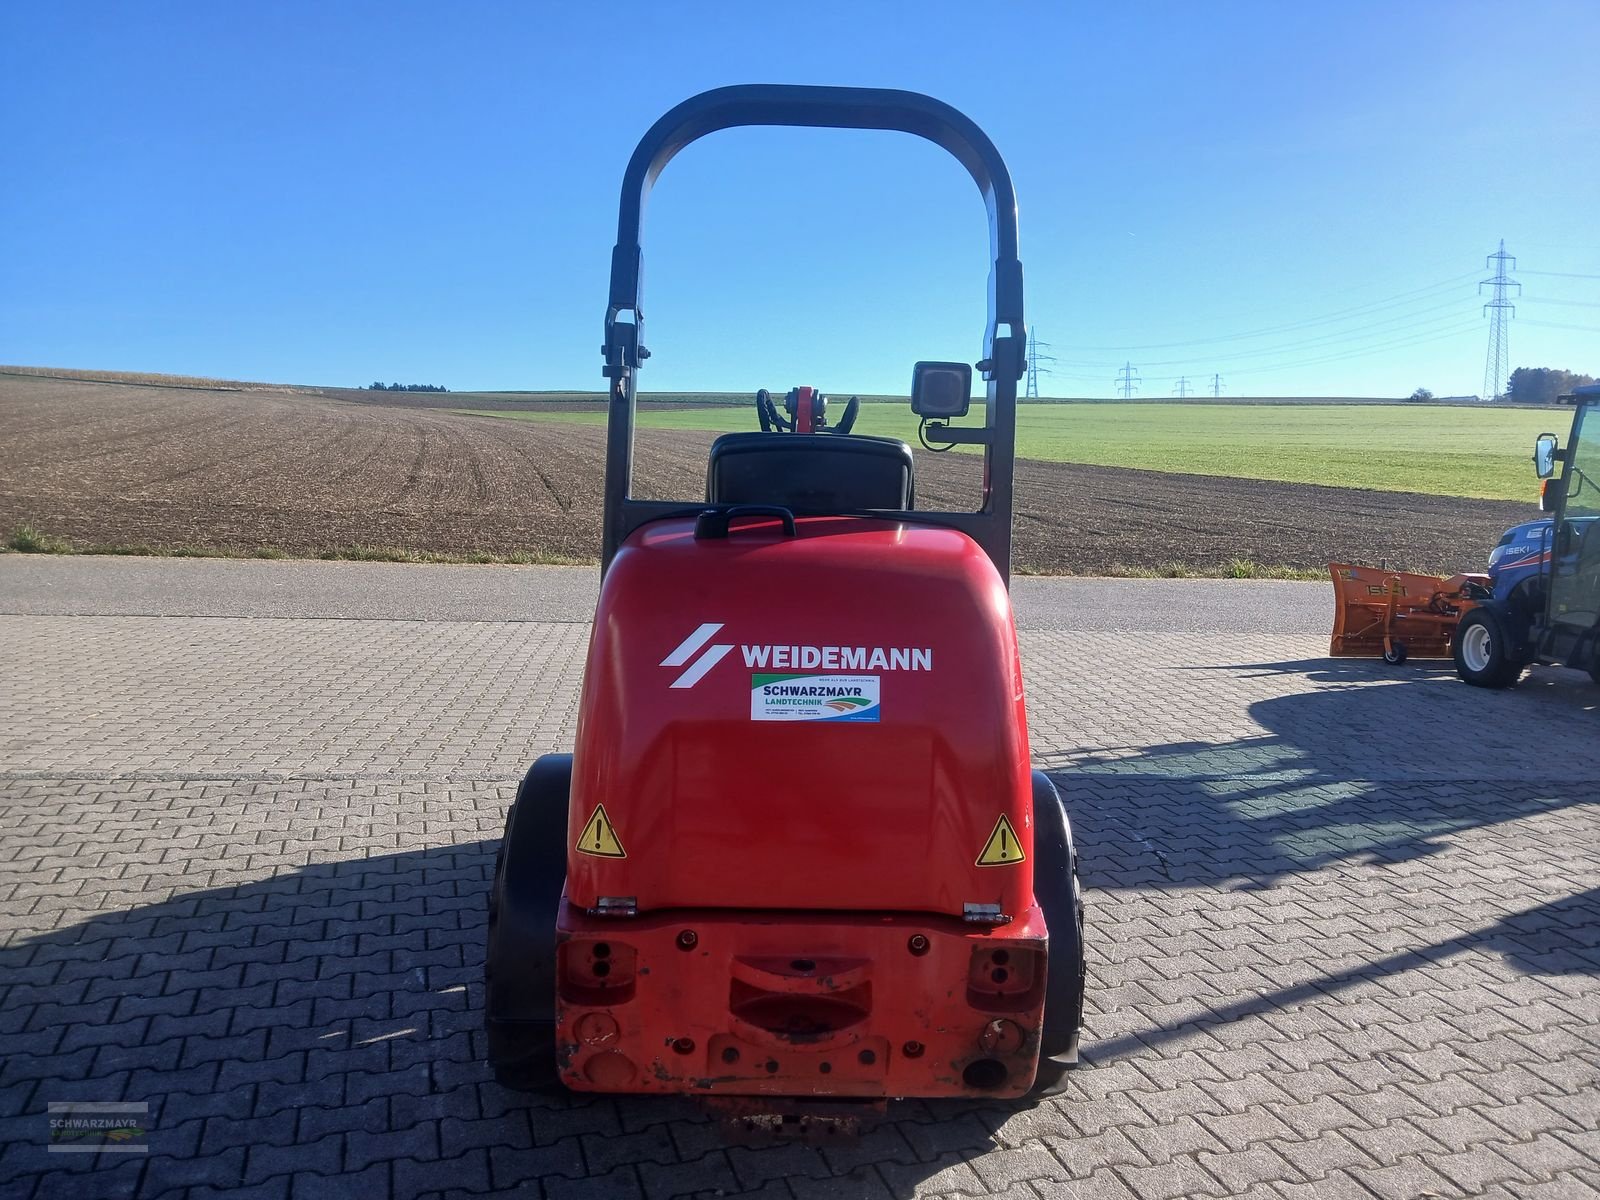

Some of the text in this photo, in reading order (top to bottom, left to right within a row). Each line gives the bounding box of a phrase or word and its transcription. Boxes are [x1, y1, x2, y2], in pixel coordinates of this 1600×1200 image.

[1505, 545, 1530, 555] ISEKI
[741, 645, 932, 671] WEIDEMANN
[763, 686, 862, 697] SCHWARZMAYR
[765, 698, 823, 706] LANDTECHNIK
